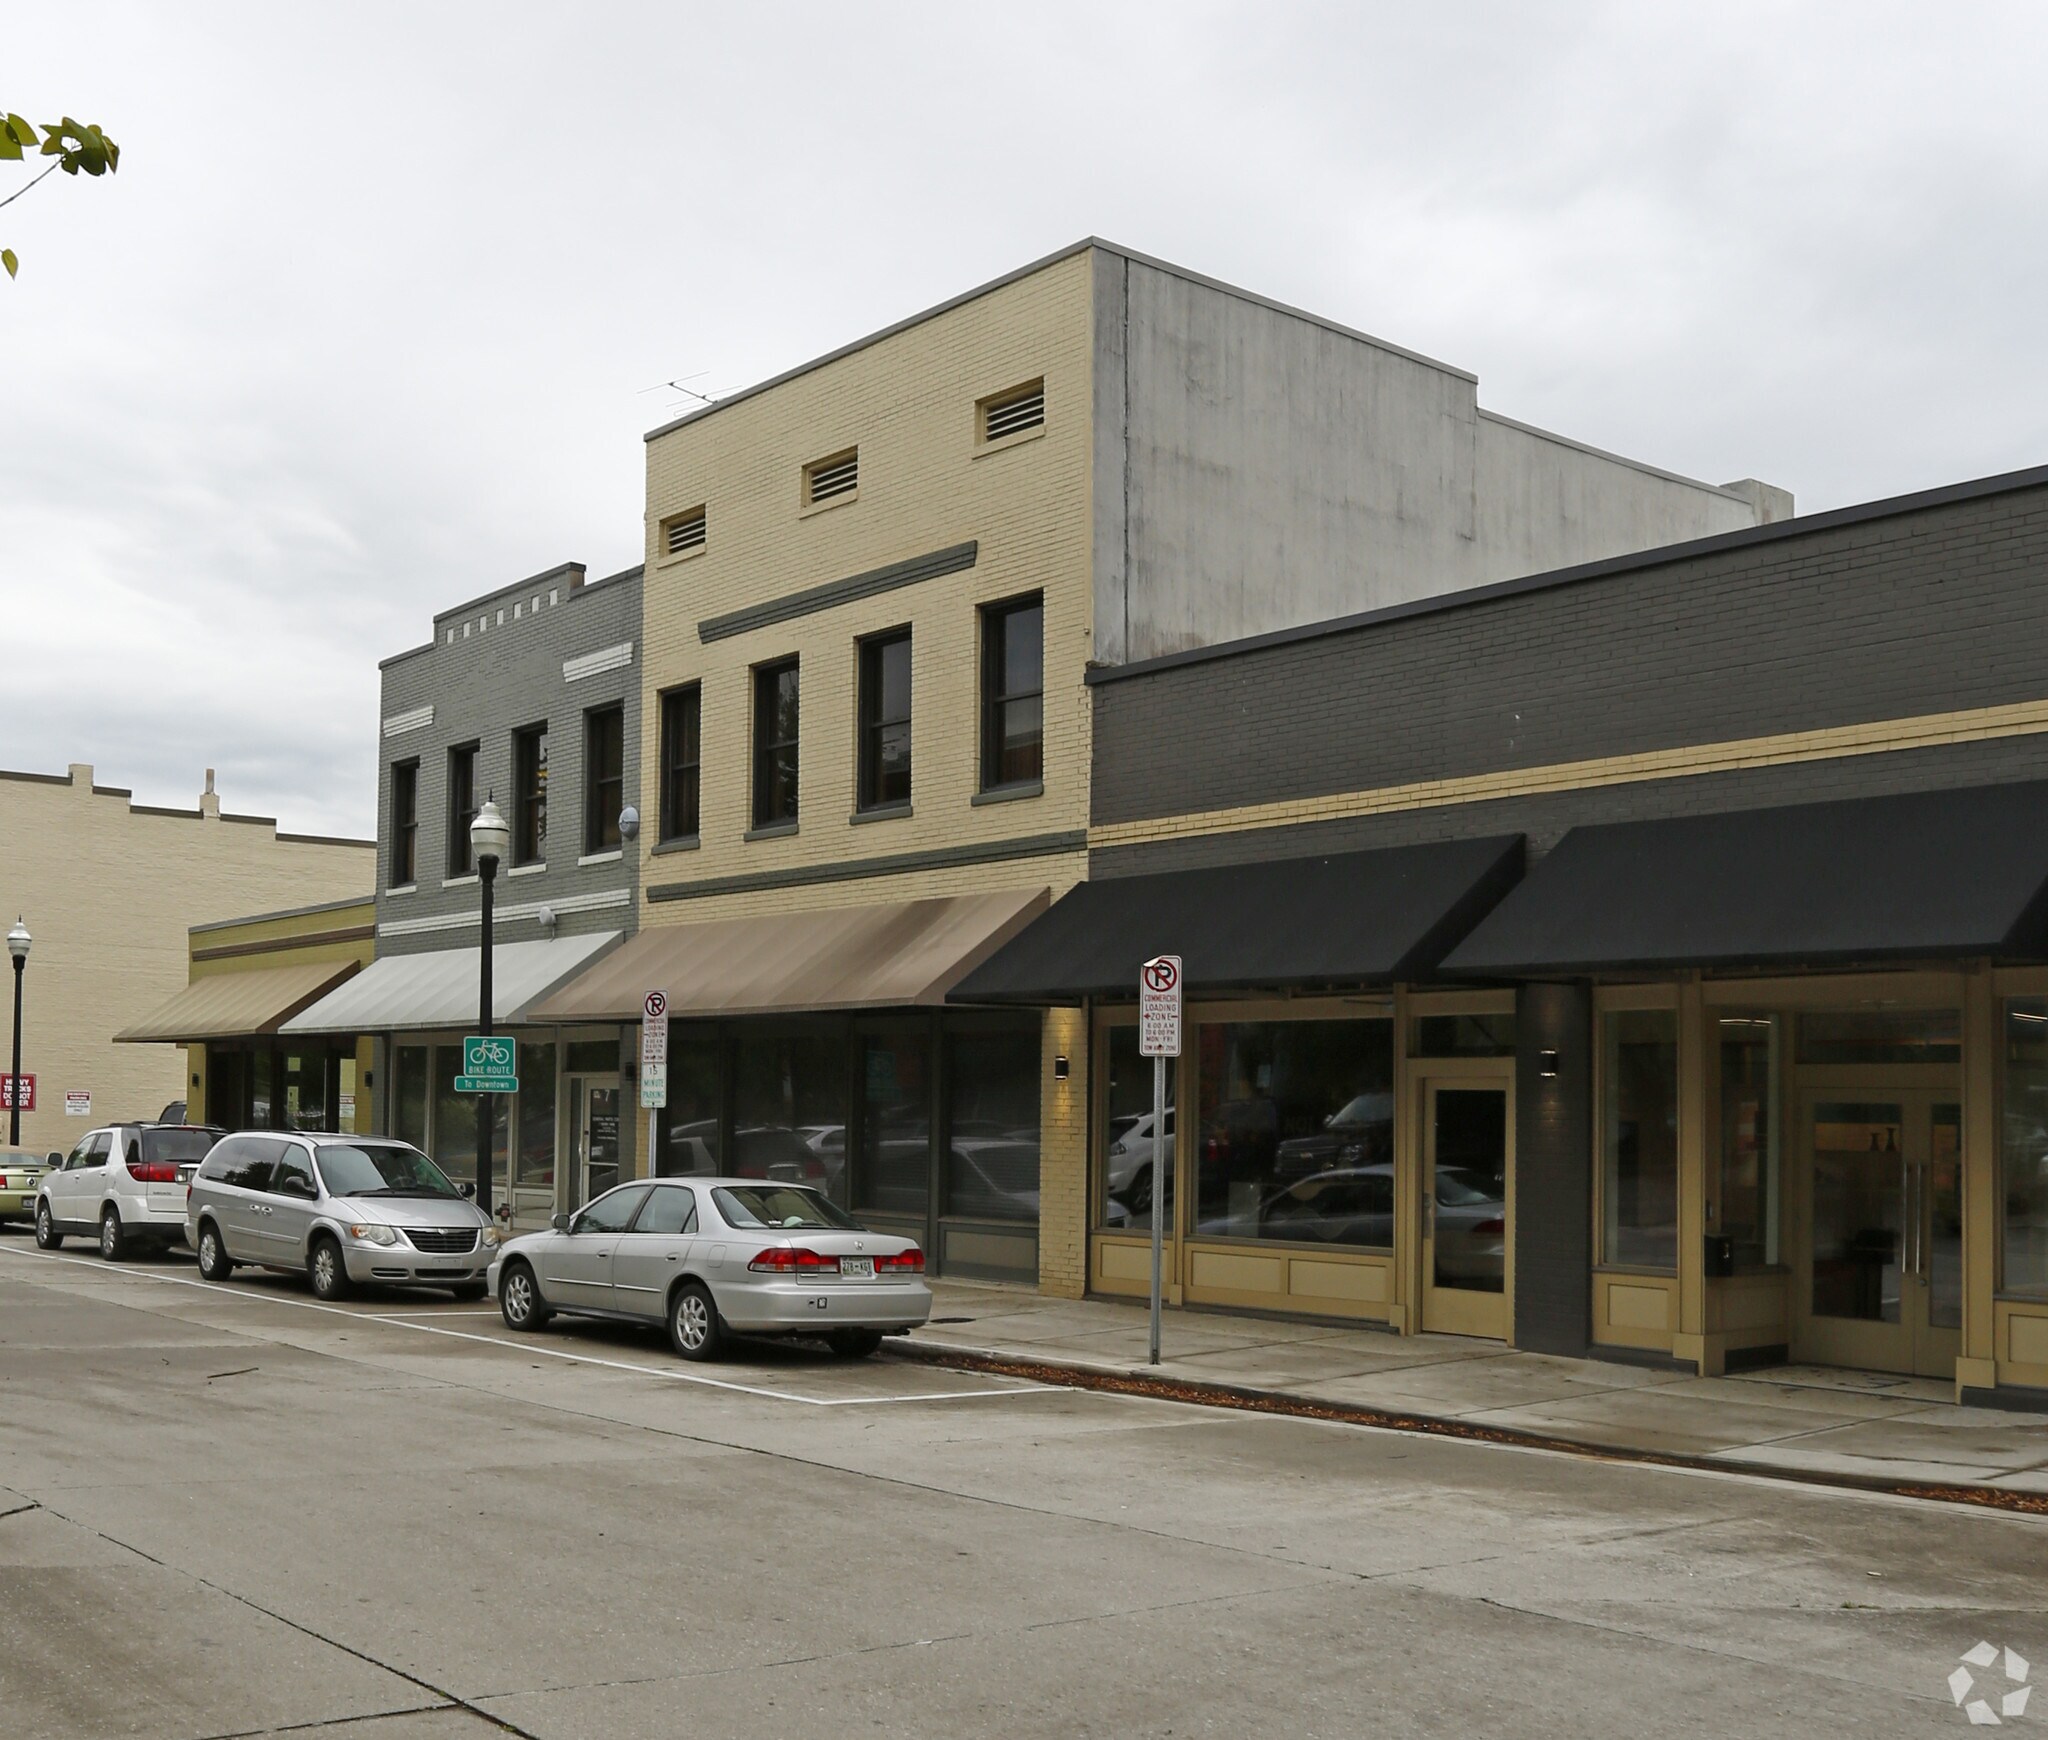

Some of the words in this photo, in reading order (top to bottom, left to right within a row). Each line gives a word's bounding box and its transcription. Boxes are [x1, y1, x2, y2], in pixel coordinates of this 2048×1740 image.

[1145, 1004, 1177, 1012] LOADING
[468, 1065, 485, 1074] BIKE
[486, 1065, 510, 1075] ROUTE
[648, 1066, 658, 1075] 15
[464, 1080, 473, 1088] To
[476, 1080, 510, 1089] Downtown
[643, 1079, 664, 1087] MINUTE
[642, 1090, 665, 1099] PARKING
